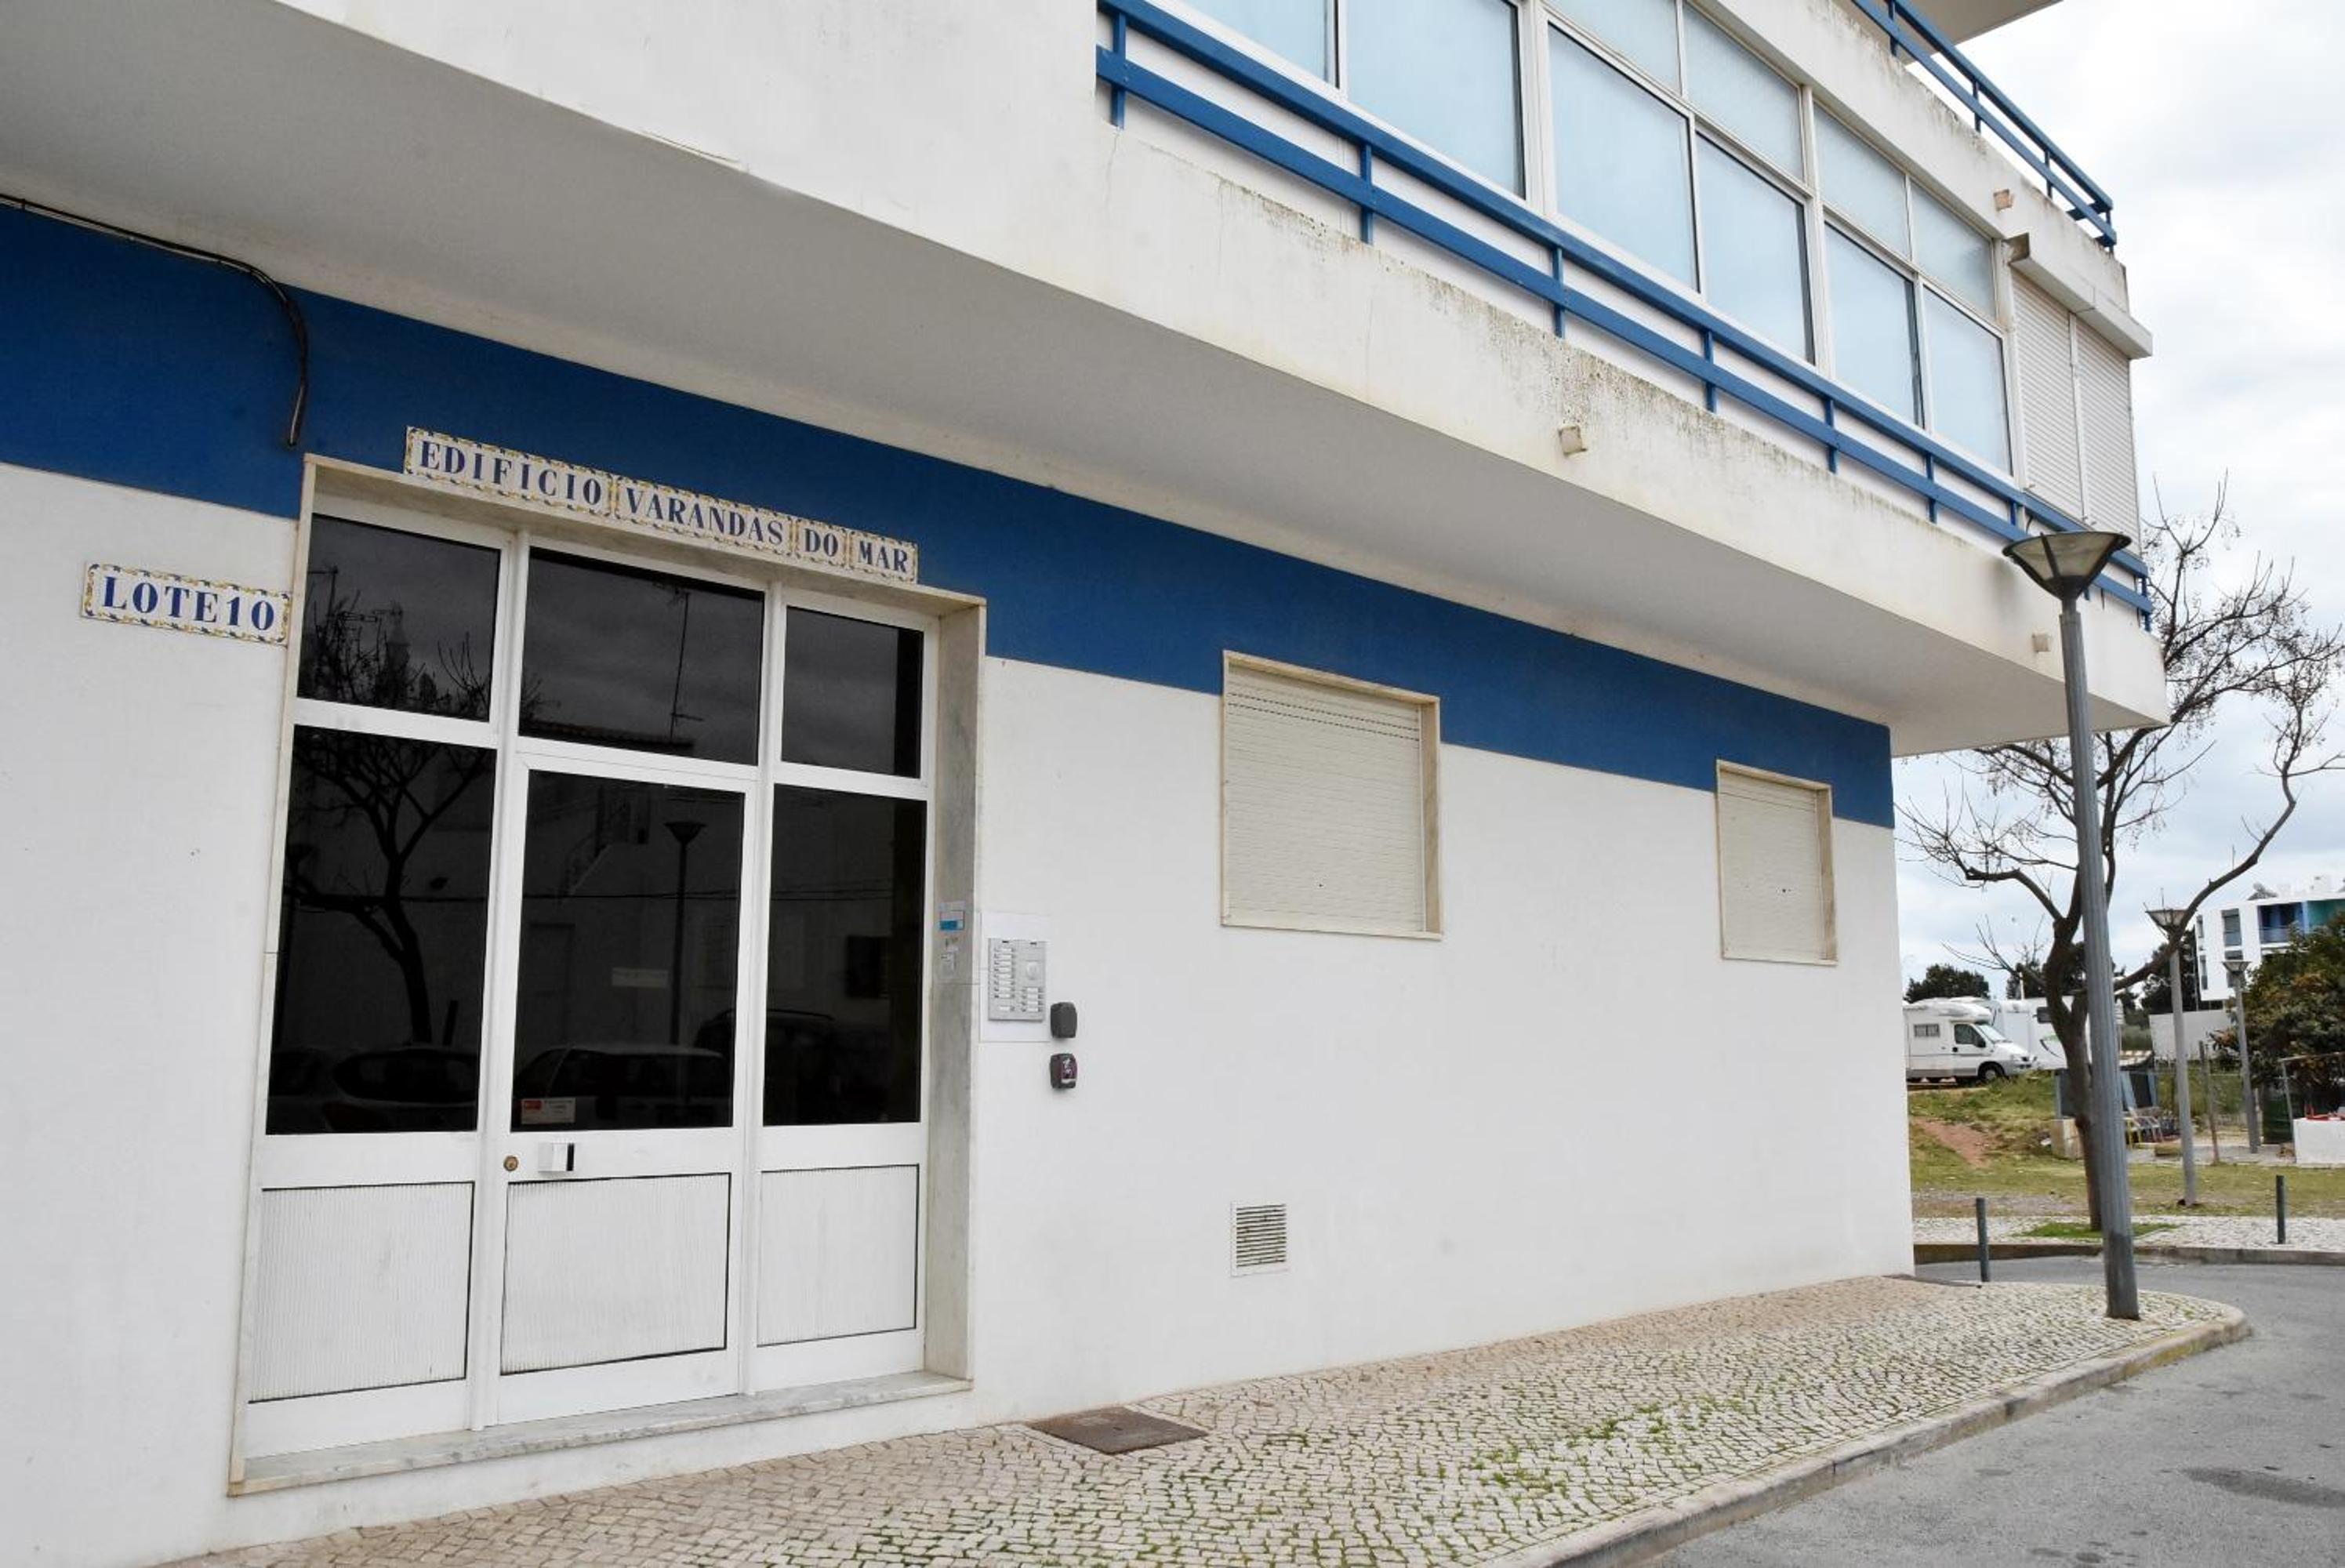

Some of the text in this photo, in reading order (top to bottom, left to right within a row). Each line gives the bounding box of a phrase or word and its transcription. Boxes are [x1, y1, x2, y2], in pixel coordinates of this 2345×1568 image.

[420, 441, 908, 573] EDIFICIO VARANDAS DO MAR
